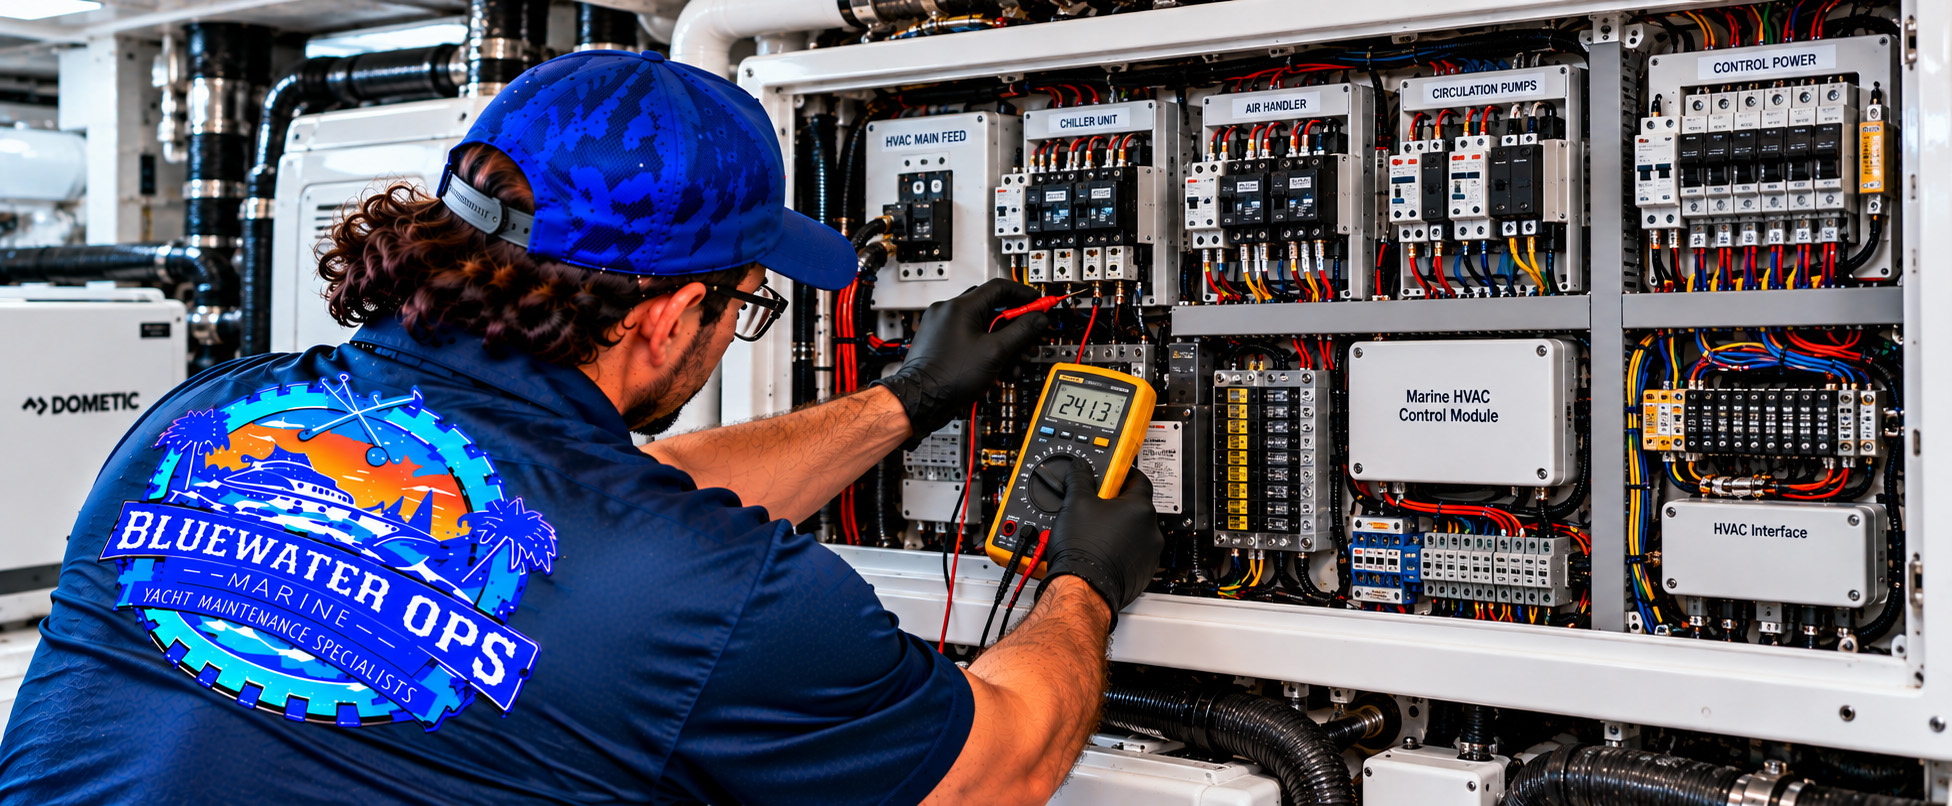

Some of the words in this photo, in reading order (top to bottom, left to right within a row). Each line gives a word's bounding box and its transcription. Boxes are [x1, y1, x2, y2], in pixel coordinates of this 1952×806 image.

[1713, 58, 1769, 74] CONTROL
[1772, 53, 1817, 68] POWER
[1432, 84, 1498, 99] CIRCULATION
[1500, 79, 1537, 93] PUMPS
[1245, 102, 1261, 114] AIR
[1263, 98, 1307, 112] HANDLER
[1059, 117, 1096, 129] CHILLER
[1097, 114, 1118, 125] UNIT
[885, 134, 912, 147] HVAC
[914, 131, 939, 145] MAIN
[941, 130, 967, 143] FEED
[51, 392, 139, 414] DOMETIC
[1406, 389, 1450, 404] Marine
[1453, 389, 1491, 404] HVAC
[1059, 394, 1112, 422] 241.3
[1399, 408, 1447, 422] Control
[1450, 408, 1499, 423] Module
[1713, 522, 1748, 536] HVAC
[1751, 523, 1808, 539] Interface
[116, 510, 390, 613] BLUEWATER
[402, 595, 516, 686] OPS
[227, 573, 347, 628] MARINE
[142, 587, 191, 607] YACHT
[196, 594, 310, 646] MAINTENANCE
[312, 635, 418, 704] SPECIALISTS
